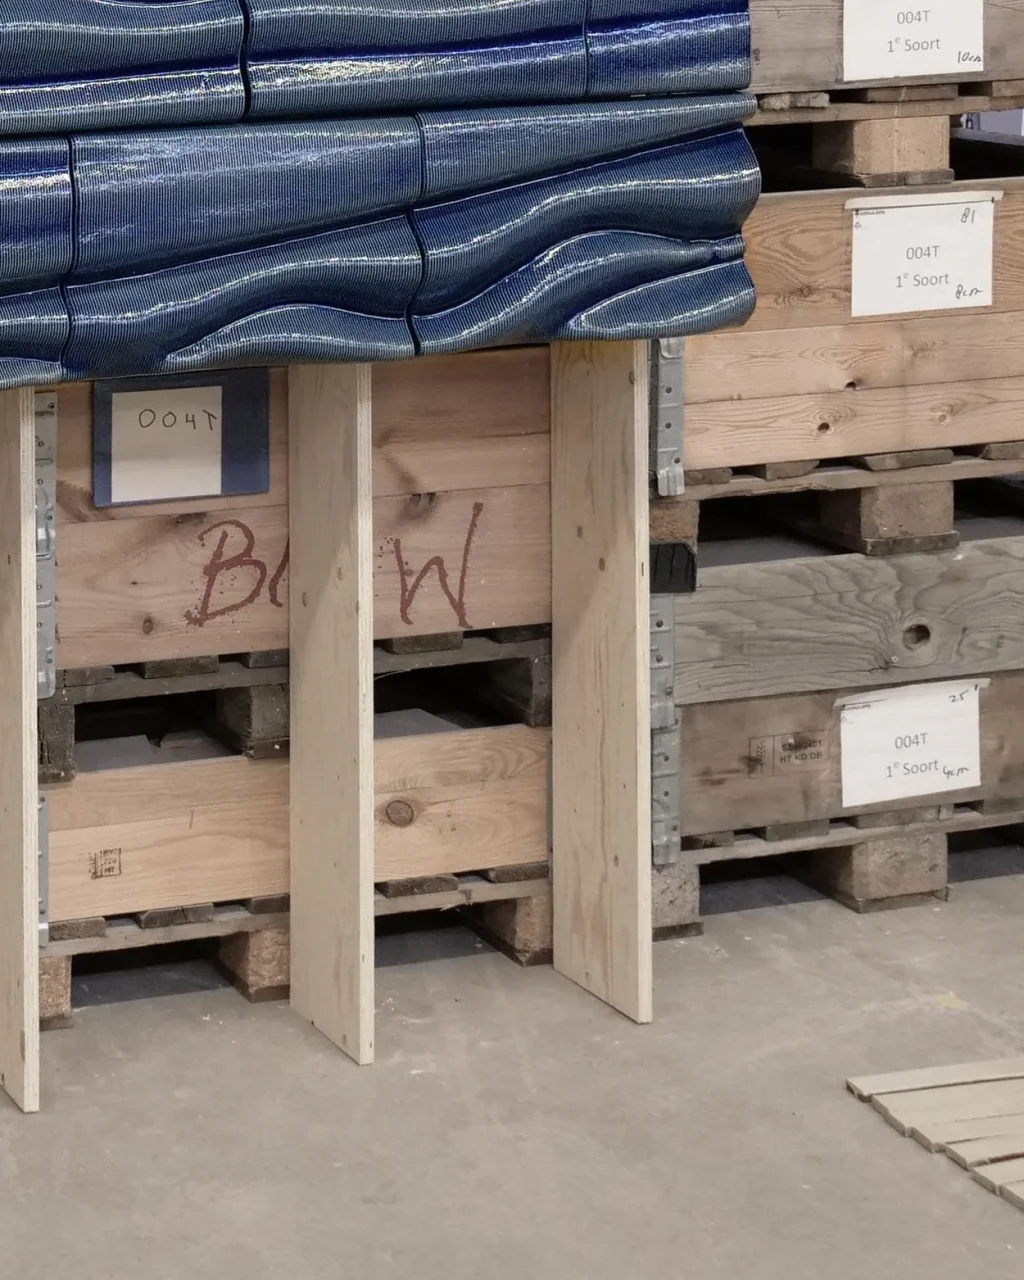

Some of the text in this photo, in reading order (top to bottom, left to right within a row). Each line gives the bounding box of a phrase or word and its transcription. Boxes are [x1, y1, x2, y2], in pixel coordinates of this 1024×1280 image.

[896, 10, 931, 25] 004T
[904, 38, 941, 52] Soort
[905, 245, 940, 260] 004T
[913, 272, 950, 287] Soort
[138, 408, 218, 431] 004T
[894, 732, 929, 750] 004T
[903, 759, 939, 776] Soort
